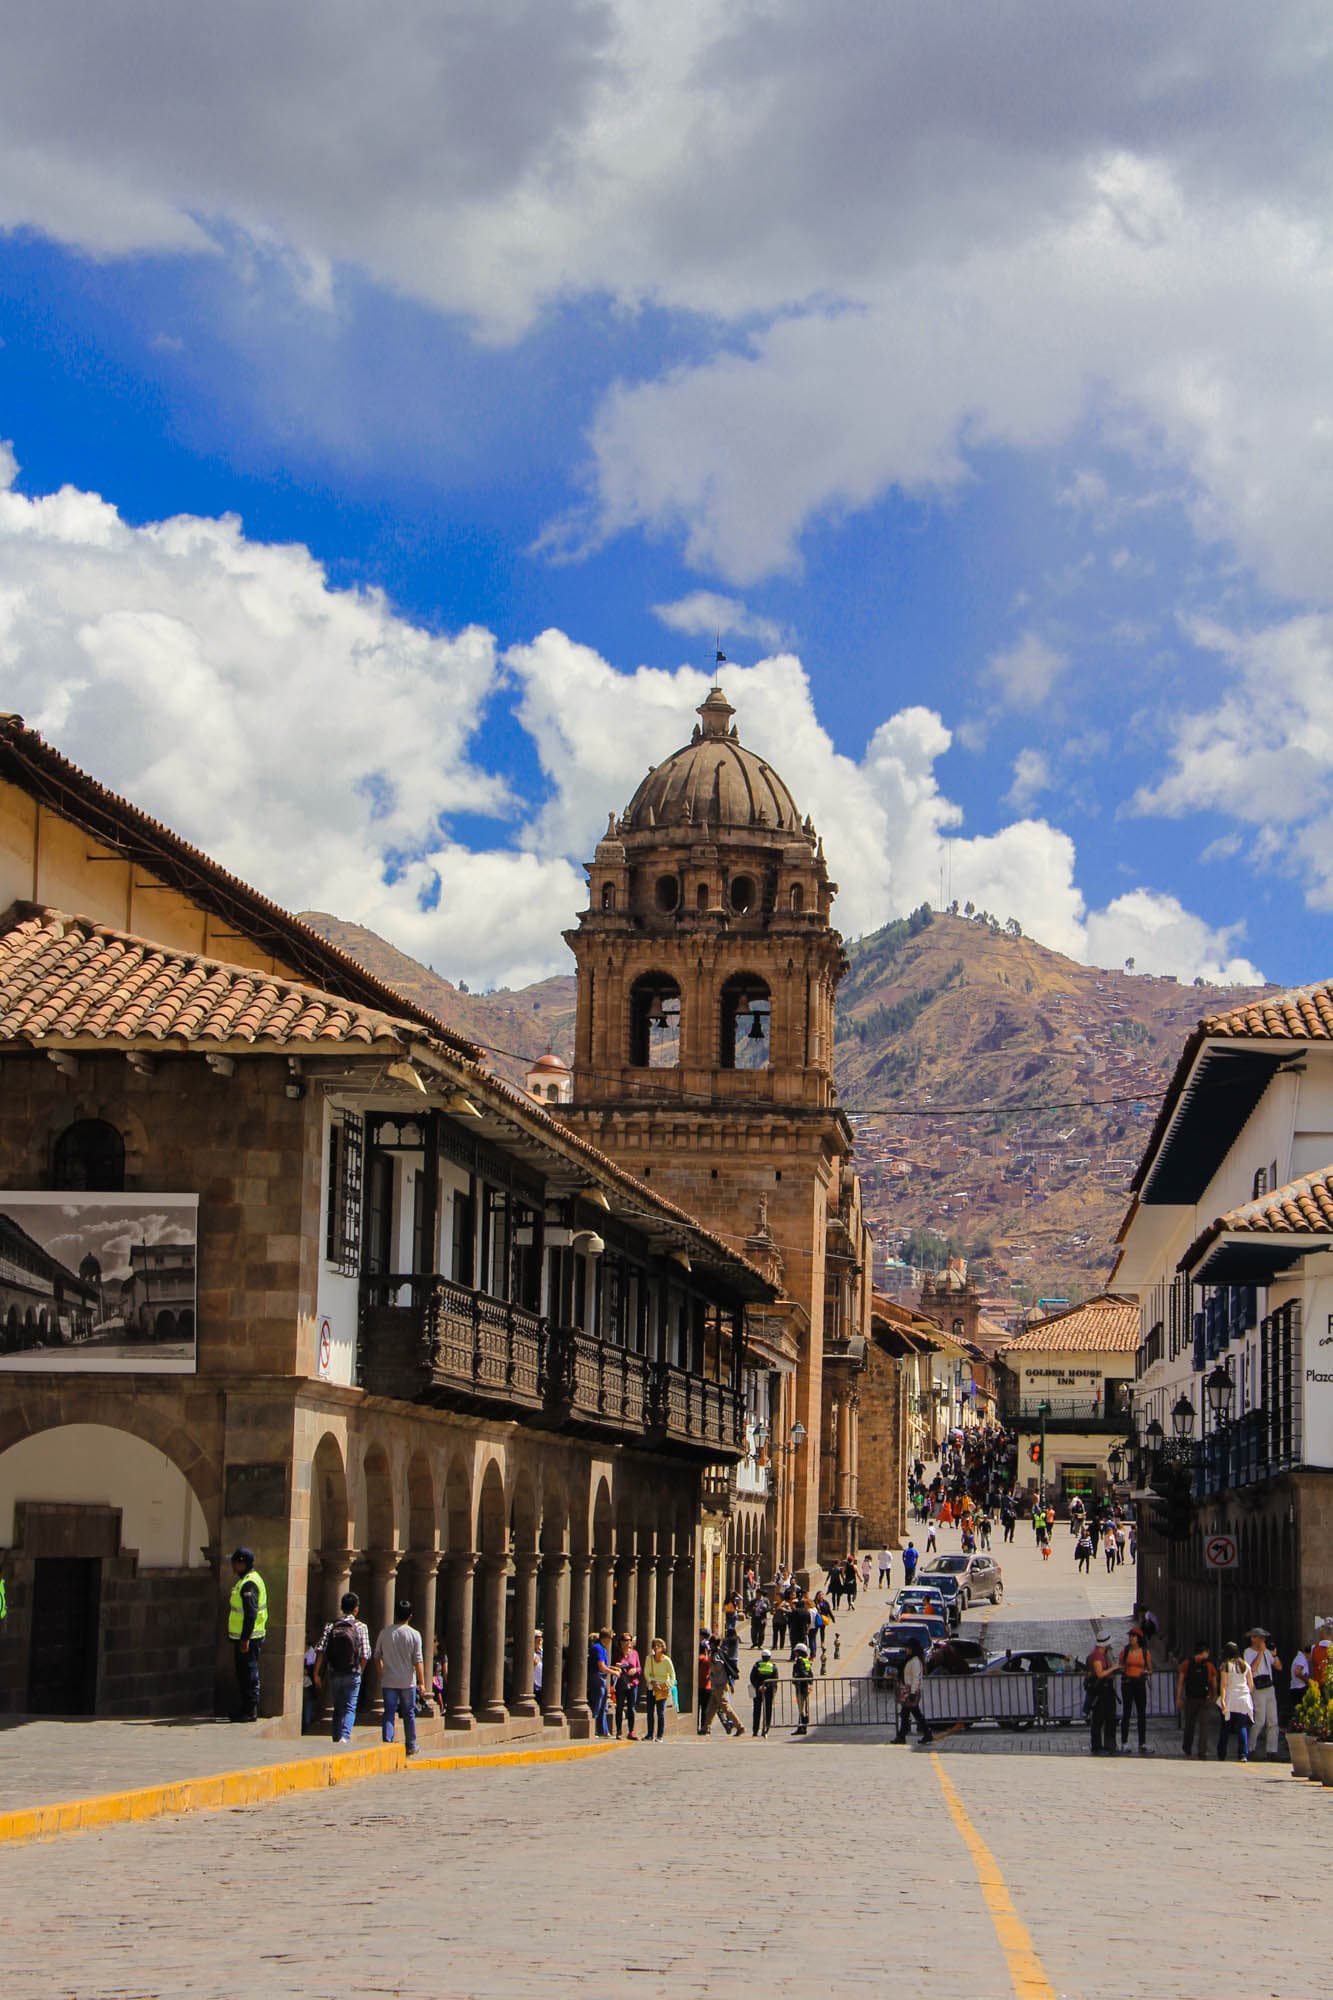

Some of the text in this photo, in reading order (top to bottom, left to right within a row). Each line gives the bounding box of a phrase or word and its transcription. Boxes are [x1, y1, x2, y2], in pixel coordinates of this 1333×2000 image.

[1025, 1369, 1103, 1377] GOLDEN HOUSE
[1057, 1377, 1075, 1385] INN
